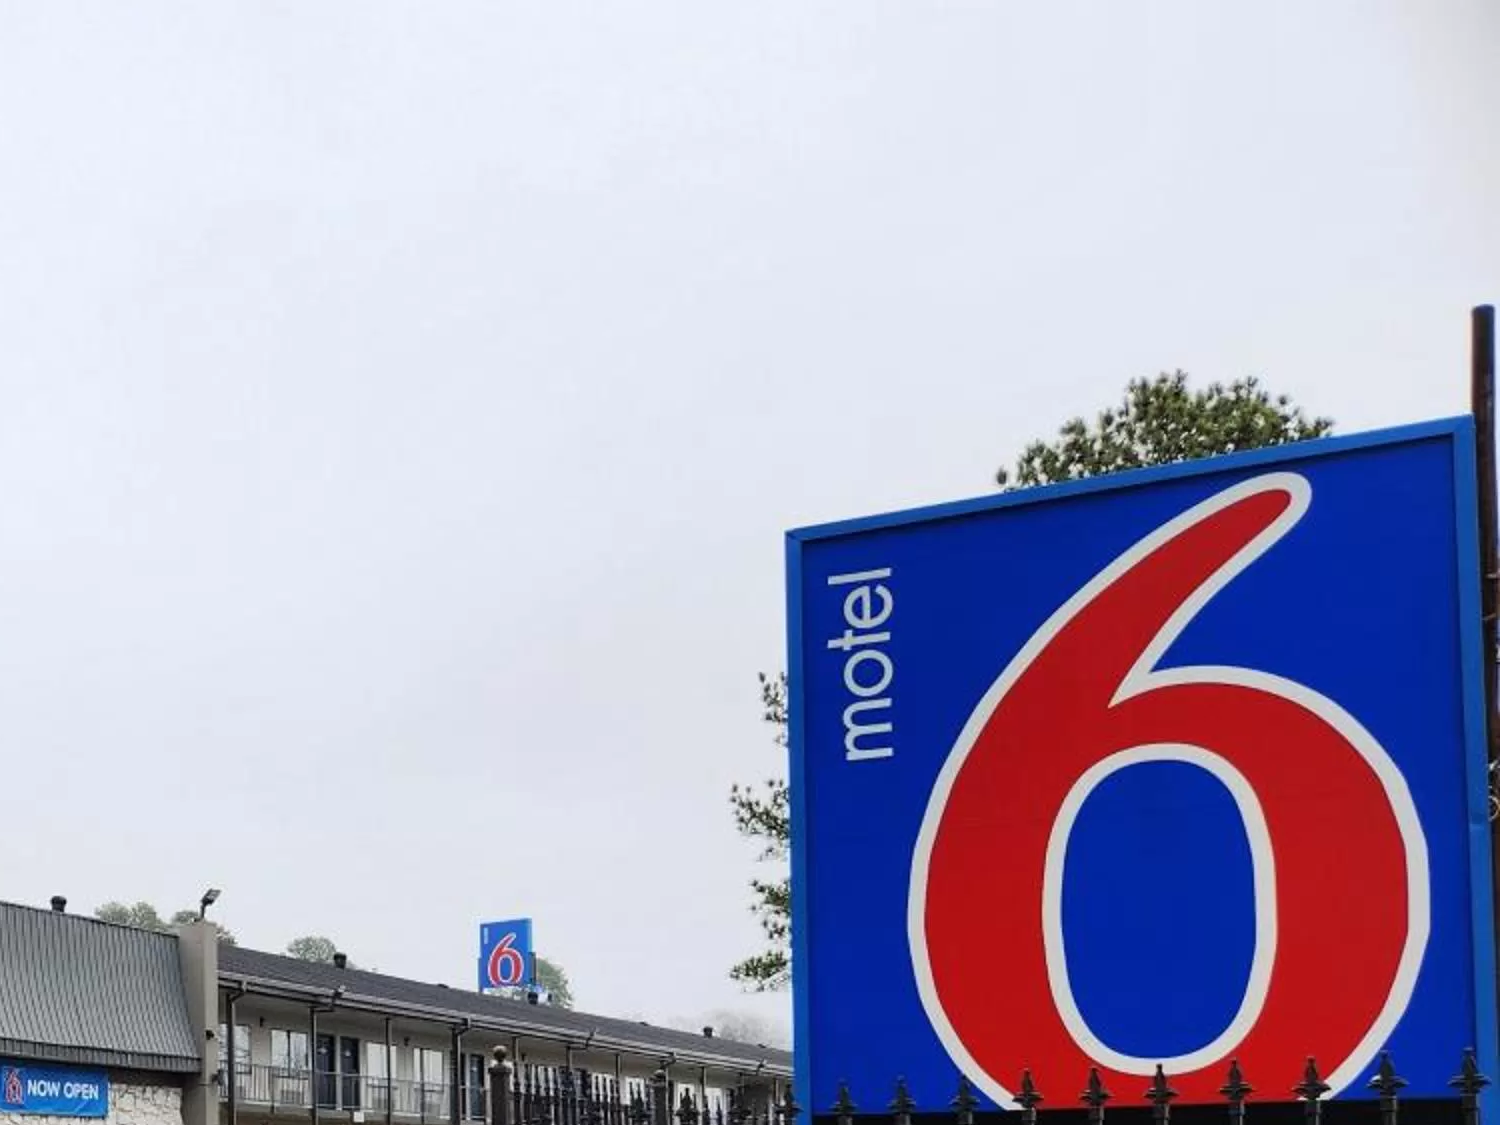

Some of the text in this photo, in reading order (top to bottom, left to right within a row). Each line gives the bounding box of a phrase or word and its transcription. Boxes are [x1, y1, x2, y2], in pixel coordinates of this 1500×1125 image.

[827, 567, 894, 760] motel
[907, 471, 1430, 1112] 6
[488, 931, 524, 987] 6
[27, 1080, 60, 1097] NOW
[63, 1082, 99, 1100] OPEN
